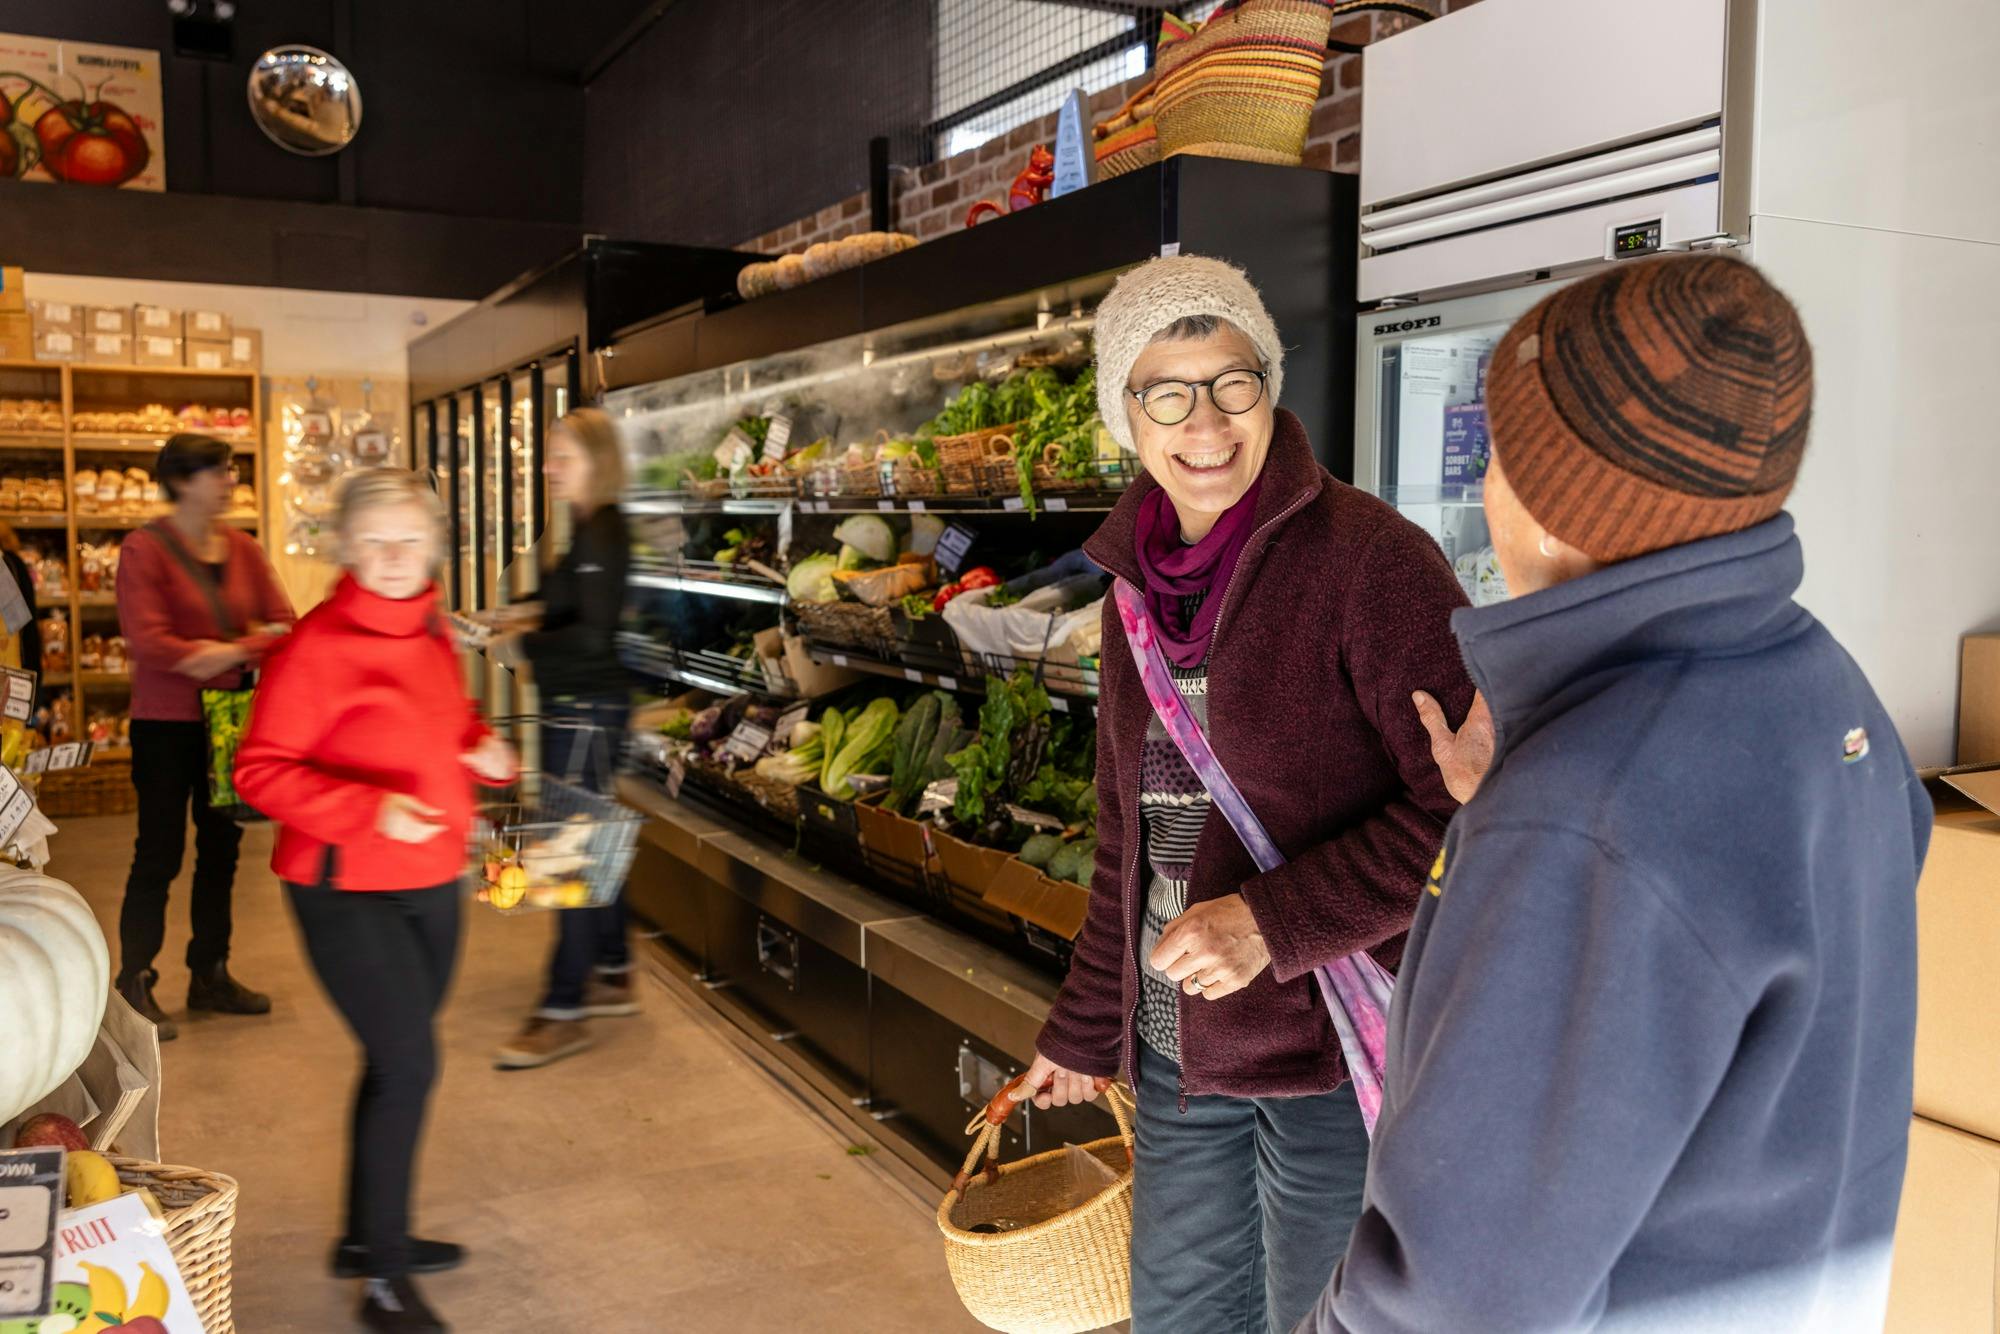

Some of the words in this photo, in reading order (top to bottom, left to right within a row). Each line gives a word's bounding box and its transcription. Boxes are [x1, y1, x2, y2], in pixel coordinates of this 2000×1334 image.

[1373, 315, 1441, 335] SKOPE
[1445, 455, 1470, 465] SORBET
[54, 1216, 117, 1258] RUIT
